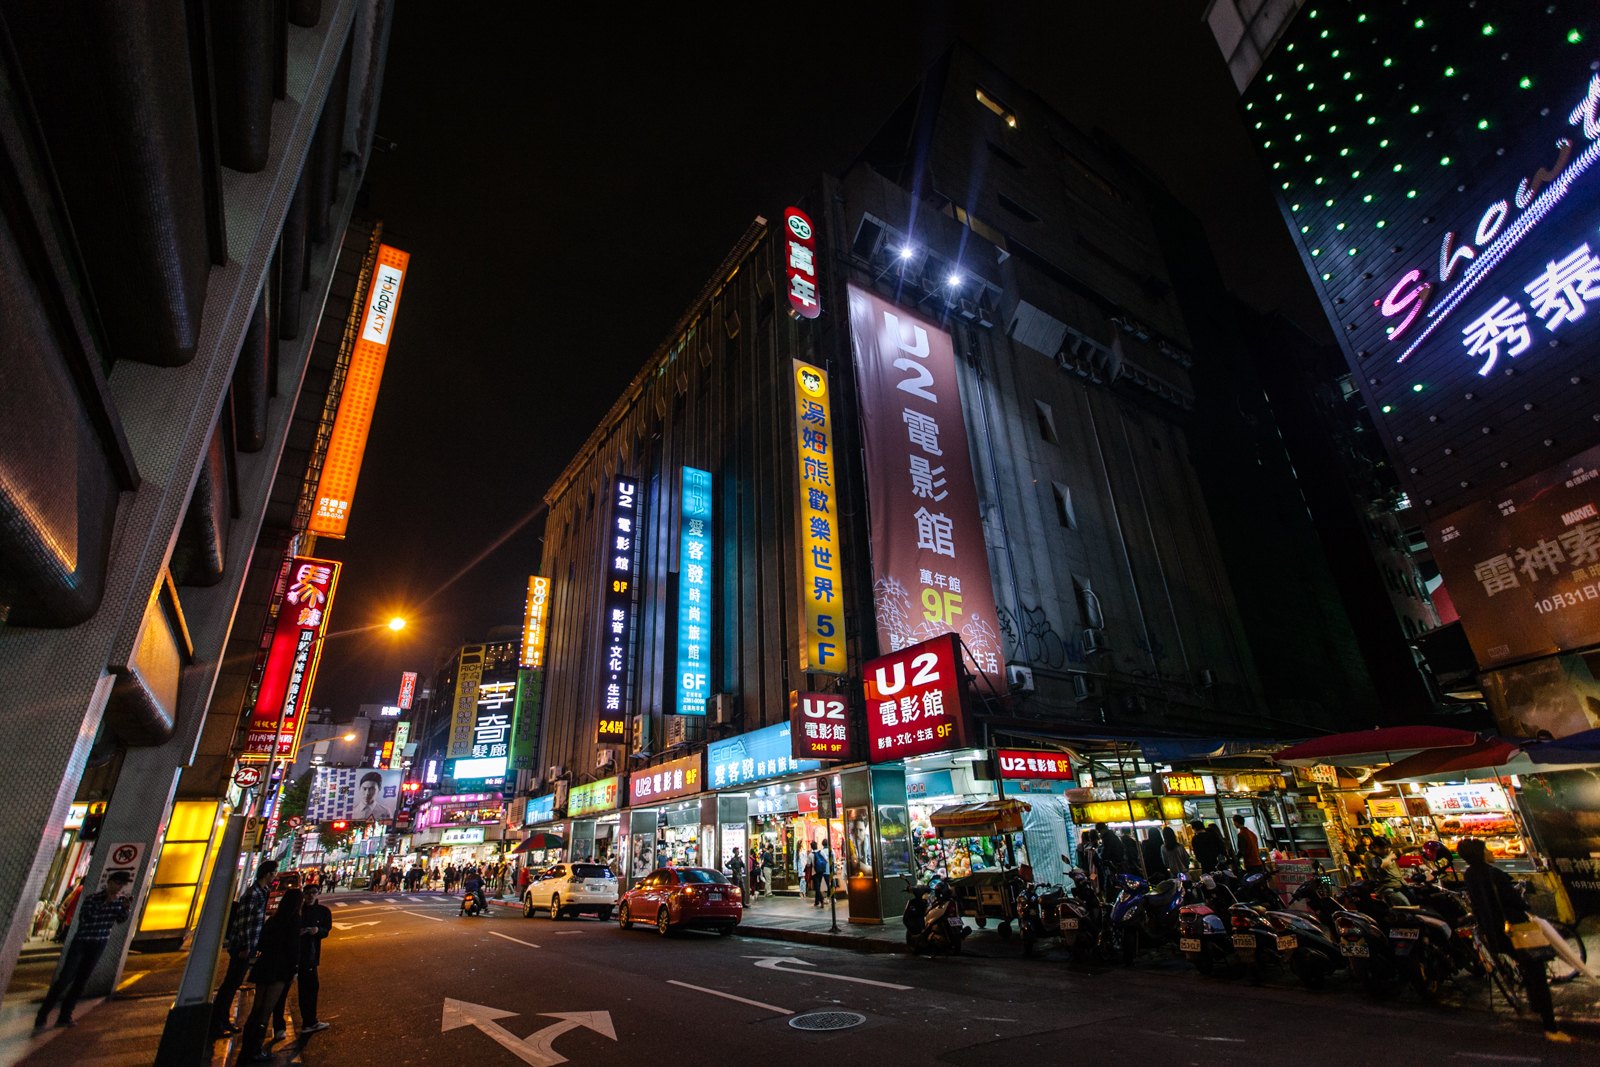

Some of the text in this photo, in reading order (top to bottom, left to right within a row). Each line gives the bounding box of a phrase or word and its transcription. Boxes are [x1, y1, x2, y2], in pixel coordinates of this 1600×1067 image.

[789, 241, 818, 308] 萬年
[373, 275, 397, 335] Holiday KTV
[884, 311, 938, 404] U2
[618, 482, 634, 508] U2
[902, 407, 955, 559] 電影館
[1561, 504, 1598, 526] MARVEL
[615, 518, 631, 571] 電影館
[801, 398, 836, 665] 湯姆熊歡樂世界 5F
[613, 580, 628, 593] 9F
[919, 568, 961, 594] 萬年館
[921, 587, 963, 626] 9F
[1534, 582, 1600, 614] 10月31日
[683, 672, 706, 690] 6F
[875, 652, 940, 696] U2
[803, 698, 845, 719] U2
[879, 689, 945, 727] 電影館
[599, 720, 624, 734] 24H
[804, 722, 846, 740] 電影館
[937, 723, 952, 738] 9F
[472, 743, 507, 758] 髮廊
[811, 743, 842, 752] 24H 9F
[237, 771, 258, 782] 24H
[1001, 757, 1069, 773] U2 電影館 9F
[606, 785, 617, 804] 5F
[635, 769, 697, 796] U2 電影館 9F
